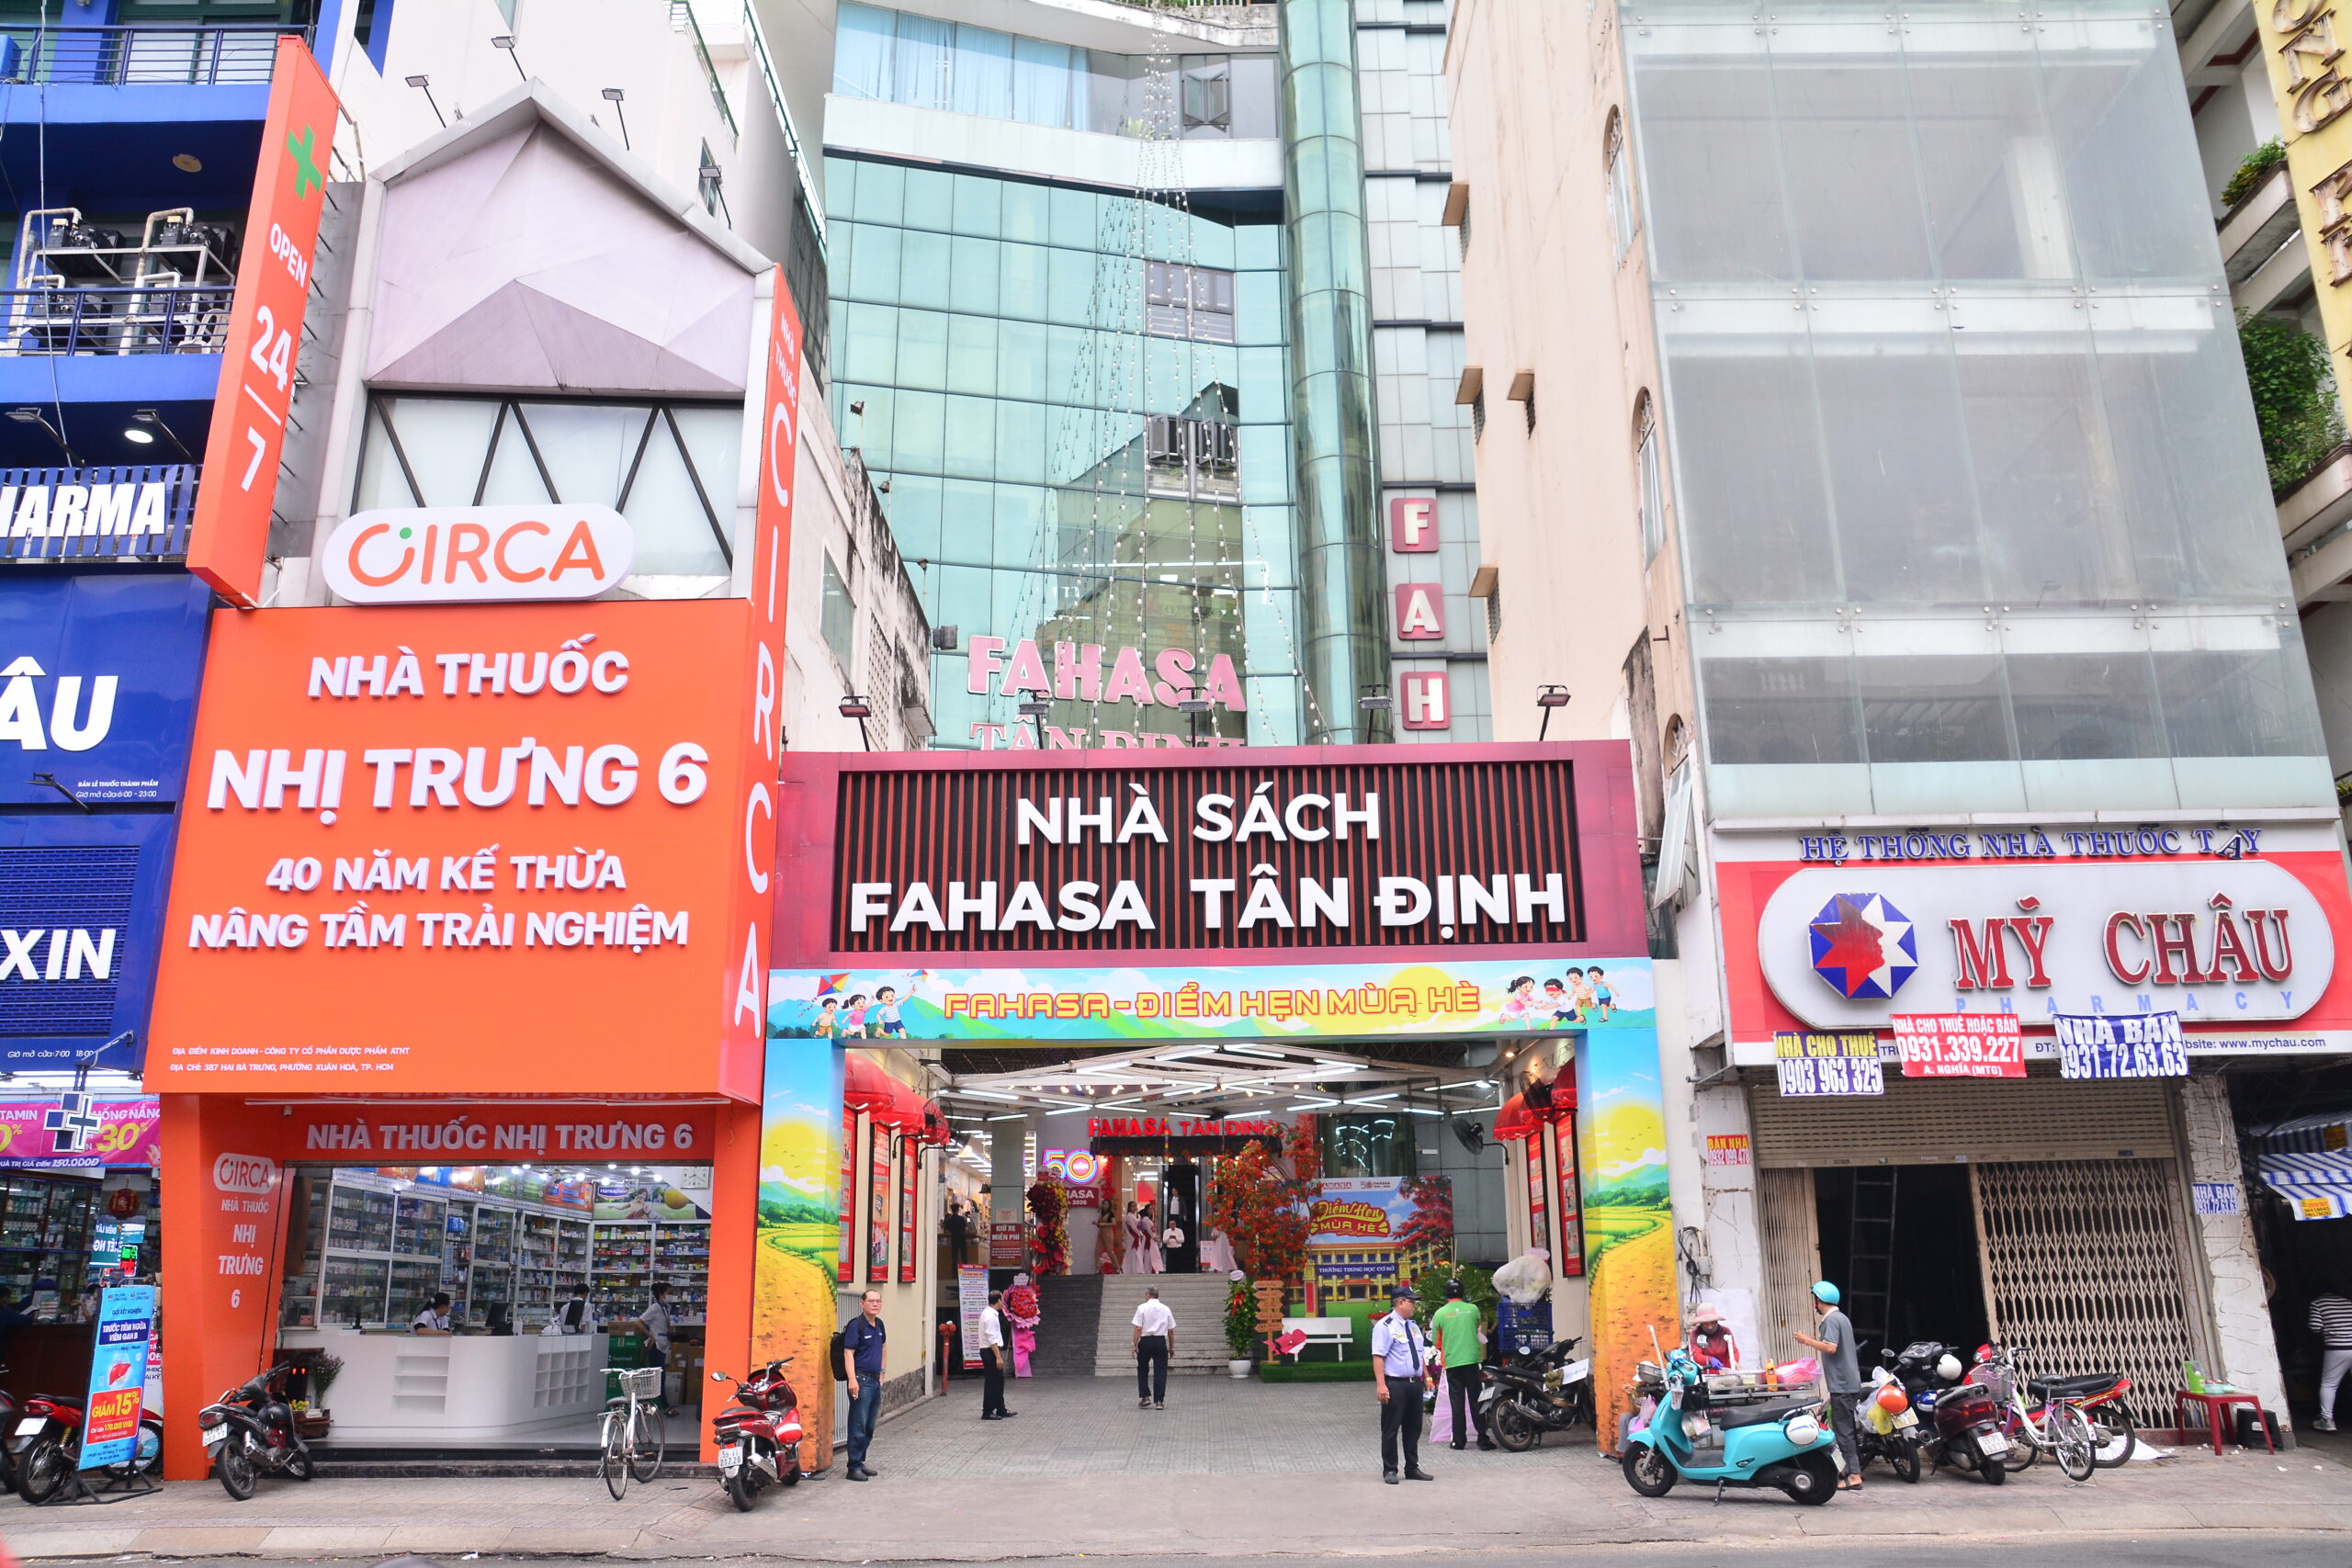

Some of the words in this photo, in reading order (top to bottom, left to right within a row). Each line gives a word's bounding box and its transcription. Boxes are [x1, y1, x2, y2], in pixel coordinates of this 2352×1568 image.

[270, 222, 308, 288] OPEN
[250, 305, 292, 392] 24
[781, 311, 795, 362] NHÀ
[775, 341, 797, 408] THUỐC
[241, 425, 266, 492] 7
[348, 520, 605, 587] CIRCA
[308, 646, 424, 698] NHÀ
[435, 633, 629, 696] THUỐC
[967, 635, 1247, 712] FAHASA
[0, 656, 119, 751] ÂU
[734, 402, 792, 1038] CIRCA
[99, 779, 119, 787] THUỐC
[207, 749, 346, 825] NHỊ
[363, 737, 639, 807] TRƯNG
[657, 742, 709, 806] 6
[1017, 783, 1169, 844] NHÀ
[1193, 781, 1379, 842] SÁCH
[1799, 829, 1850, 867] HỆ
[1854, 828, 1971, 860] THỐNG
[1980, 825, 2057, 859] NHÀ
[2064, 823, 2182, 858] THUỐC
[266, 856, 322, 891] 40
[333, 848, 429, 891] NĂM
[440, 843, 500, 890] KẾ
[510, 846, 627, 890] THỪA
[851, 880, 1156, 932] FAHASA
[1191, 863, 1350, 929] TÂN
[1374, 873, 1566, 940] ĐỊNH
[187, 906, 308, 948] NÂNG
[319, 900, 407, 948] TẦM
[416, 903, 514, 947] TRẢI
[525, 904, 689, 953] NGHIỆM
[1947, 896, 2055, 989] MỸ
[2102, 890, 2294, 985] CHÂU
[0, 929, 117, 980] XIN
[944, 991, 1112, 1020] FAHASA
[1136, 981, 1231, 1019] ĐIỂM
[1239, 987, 1320, 1021] HẸN
[1327, 982, 1417, 1016] MÙA
[1427, 980, 1480, 1013] HÈ
[1775, 1033, 1801, 1057] NHÀ
[1806, 1034, 1836, 1056] CHO
[1839, 1031, 1878, 1056] THUÊ
[1892, 1017, 1916, 1034] NHÀ
[1917, 1018, 1937, 1033] CHO
[1938, 1017, 1964, 1032] THUÊ
[1967, 1017, 1994, 1036] HOẶC
[1996, 1017, 2018, 1032] BÁN
[2035, 1042, 2055, 1053] ĐT:
[2185, 1038, 2217, 1049] bsite:
[2219, 1037, 2326, 1054] www.mychau.com
[2055, 1014, 2116, 1045] NHÀ
[2120, 1013, 2183, 1044] BÁN
[170, 1064, 183, 1072] ĐỊA
[236, 1062, 246, 1071] BÀ
[249, 1063, 277, 1073] TRƯNG,
[279, 1062, 312, 1071] PHƯỜNG
[315, 1063, 337, 1072] XUÂN
[361, 1064, 373, 1072] TP.
[172, 1047, 186, 1056] ĐỊA
[188, 1046, 208, 1055] ĐIỂM
[209, 1047, 229, 1055] KINH
[231, 1047, 258, 1055] DOANH
[265, 1046, 287, 1055] CÔNG
[301, 1045, 313, 1055] CỔ
[315, 1045, 337, 1055] PHẦN
[339, 1046, 362, 1056] DƯỢC
[364, 1045, 387, 1055] PHẨM
[1897, 1035, 2020, 1063] 0931.339.227
[1778, 1060, 1815, 1094] 0903
[1819, 1059, 1849, 1093] 963
[1852, 1058, 1883, 1092] 325
[1923, 1065, 1935, 1075] A.
[1937, 1063, 1970, 1075] NGHĨA
[1972, 1065, 2002, 1077] (MTG)
[307, 1119, 372, 1150] NHÀ
[379, 1115, 486, 1150] THUỐC
[493, 1123, 546, 1156] NHỊ
[555, 1120, 666, 1150] TRƯNG
[673, 1123, 694, 1150] 6
[1088, 1117, 1172, 1137] FAHASA
[11, 1160, 21, 1168] TRỊ
[22, 1159, 34, 1168] GIÁ
[220, 1158, 270, 1190] CIRCA
[221, 1197, 239, 1213] NHÀ
[243, 1197, 269, 1213] THUỐC
[233, 1224, 256, 1248] NHỊ
[1320, 1219, 1352, 1231] MÙA
[1357, 1221, 1376, 1233] HÈ
[219, 1253, 264, 1276] TRƯNG
[231, 1289, 241, 1309] 6
[92, 1400, 115, 1418] GIẢM
